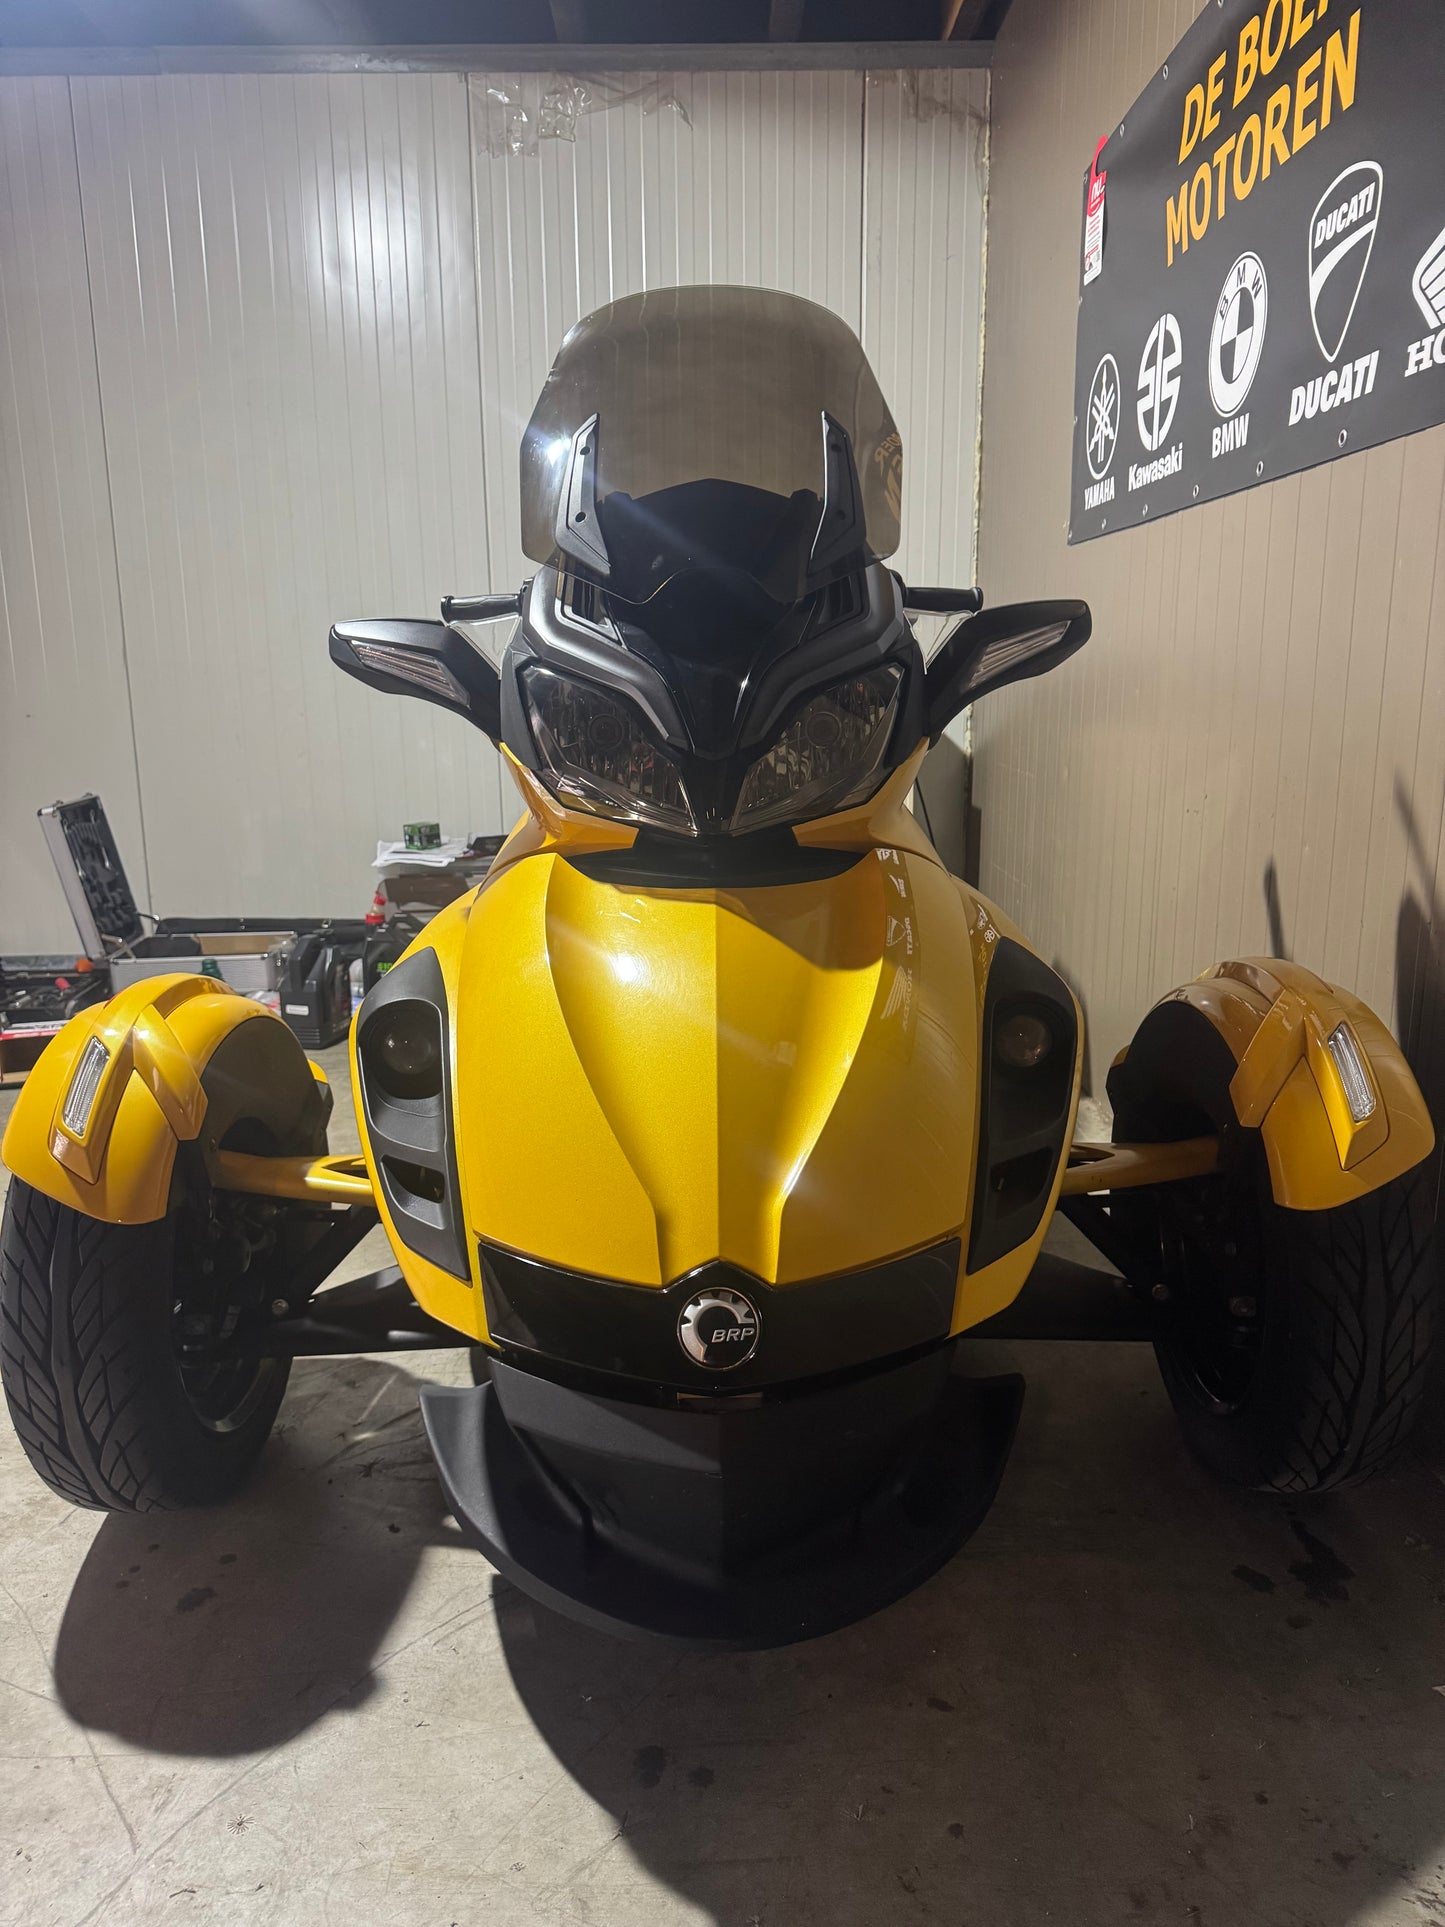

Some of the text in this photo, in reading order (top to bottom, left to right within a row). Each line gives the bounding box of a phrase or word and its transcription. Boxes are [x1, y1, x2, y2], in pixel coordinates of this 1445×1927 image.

[1178, 0, 1329, 166] DE BO
[1165, 8, 1361, 267] MOTOREN
[1314, 182, 1376, 249] DUCATI
[1219, 262, 1263, 320] BMW
[1288, 350, 1379, 426] DUCATI
[1212, 413, 1250, 459] BMW
[1084, 476, 1115, 511] YAMAHA
[1128, 443, 1183, 492] Kawasaki
[711, 1327, 755, 1343] BRP
